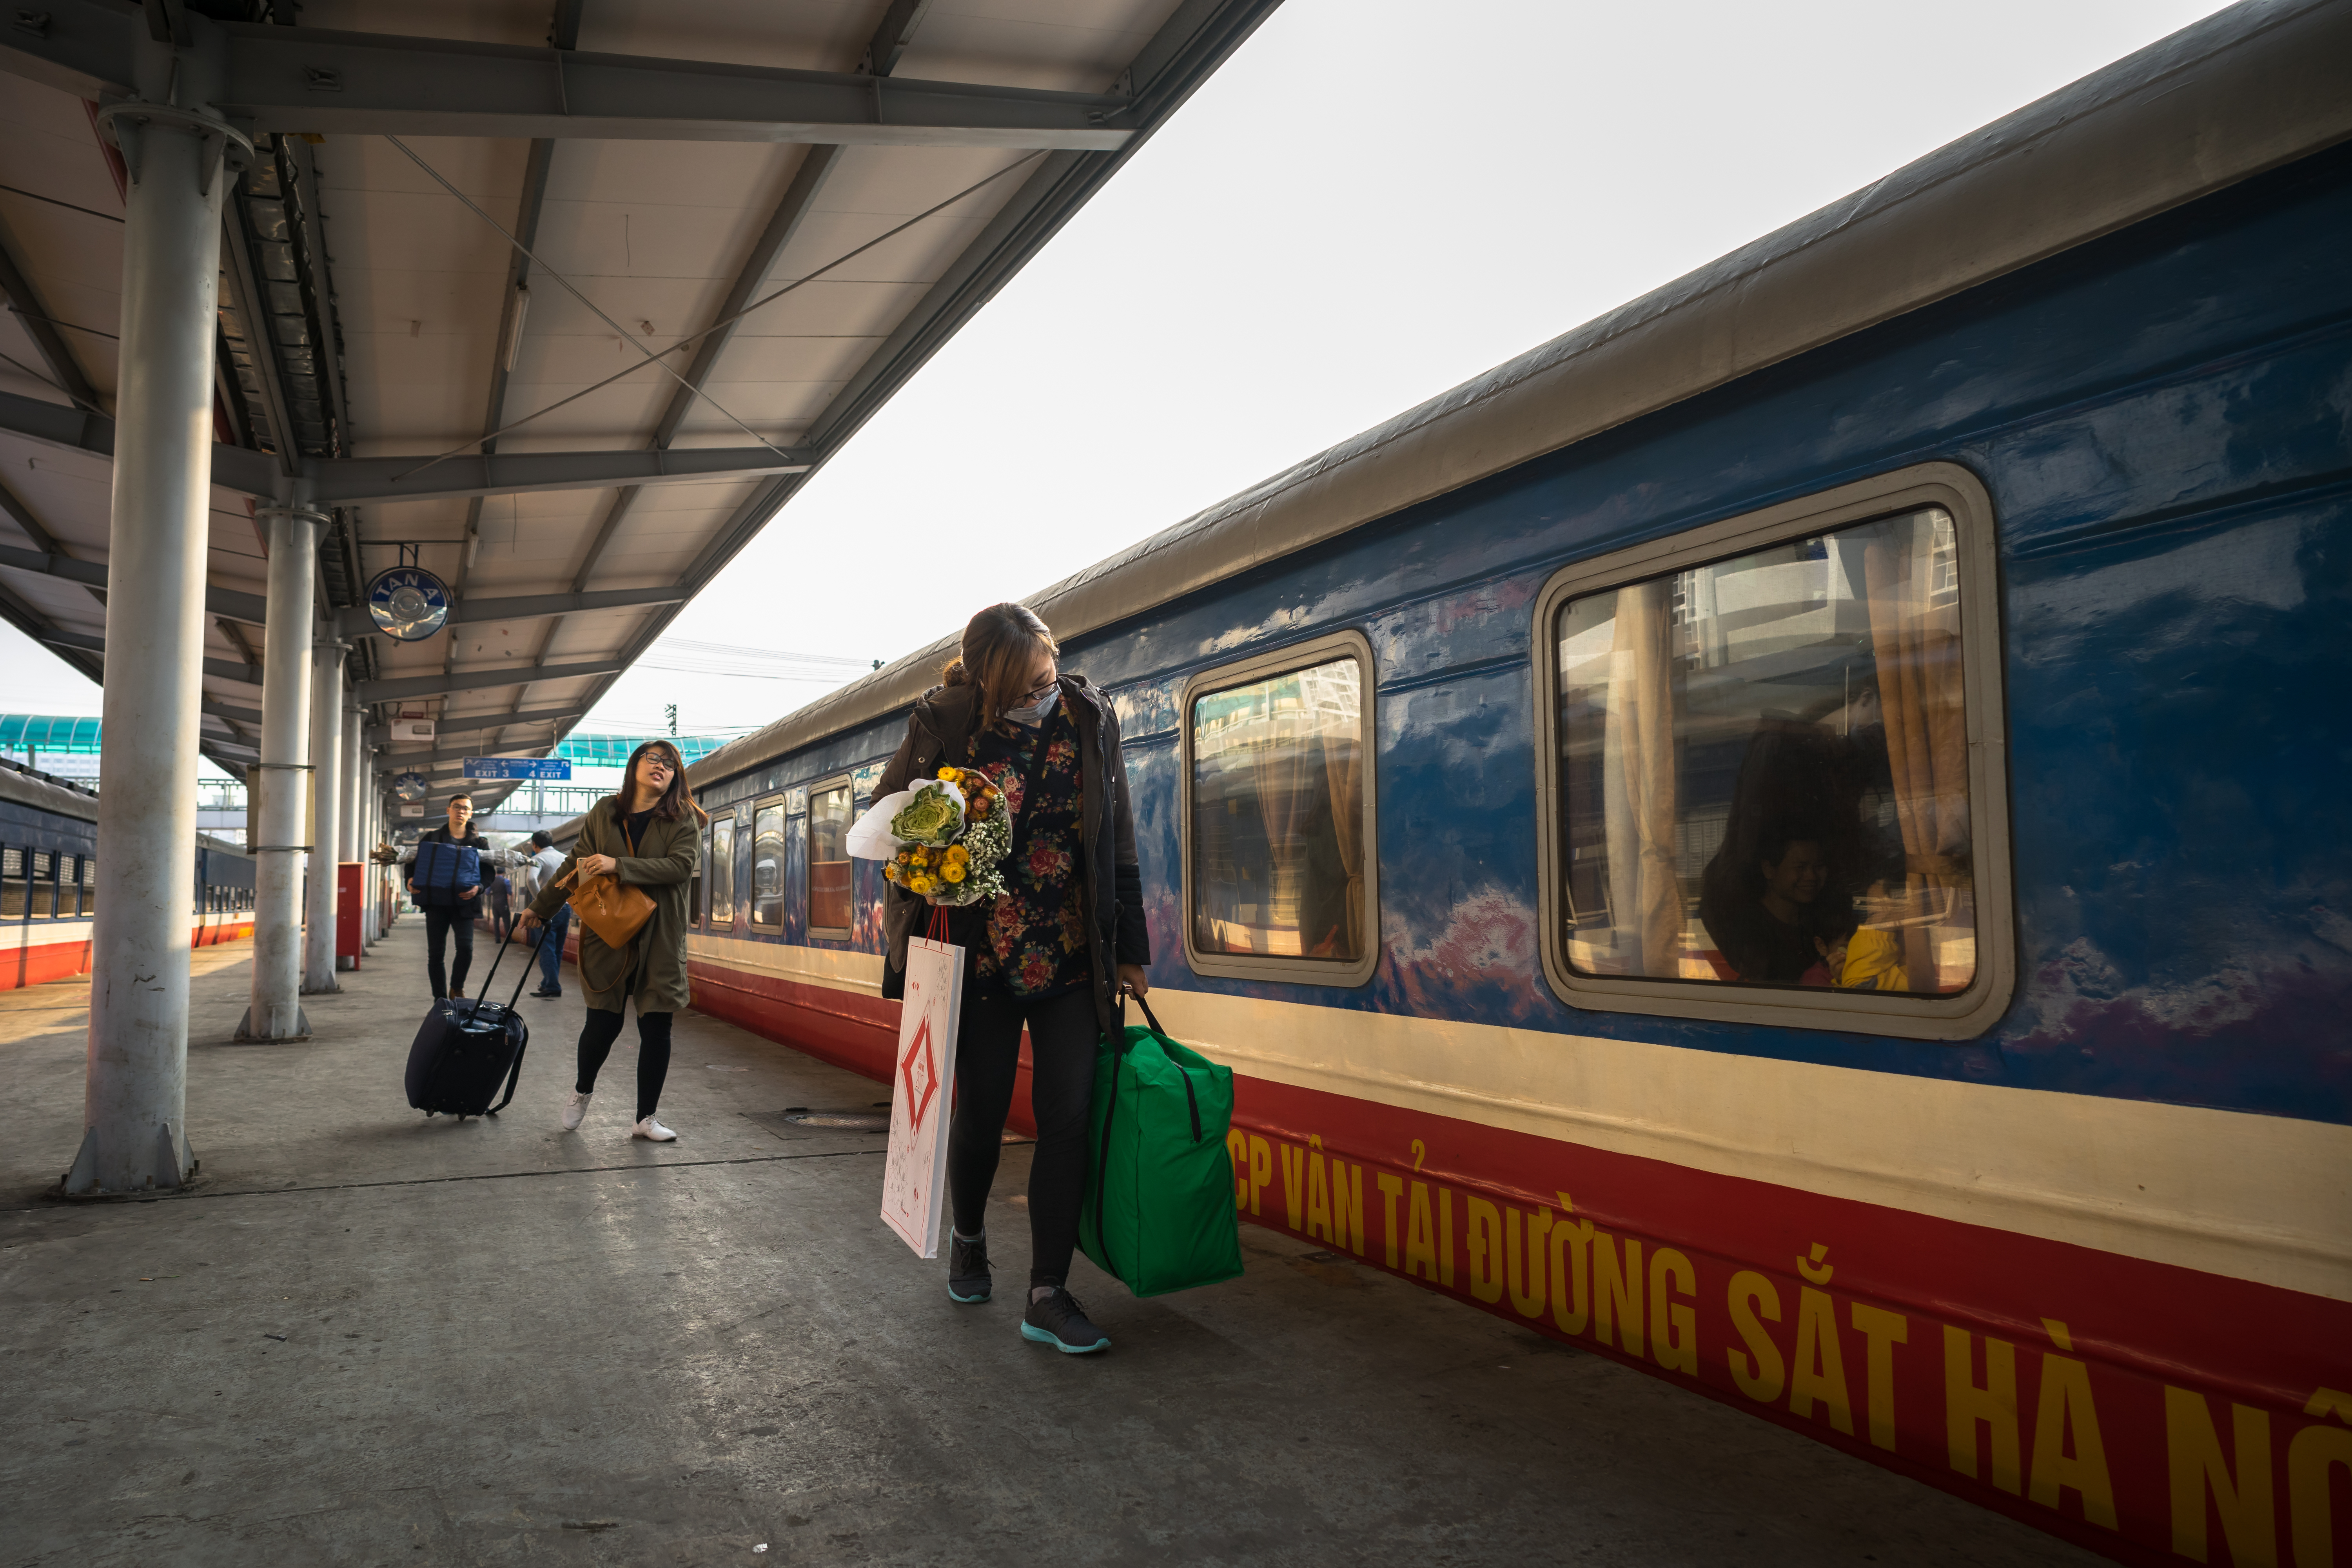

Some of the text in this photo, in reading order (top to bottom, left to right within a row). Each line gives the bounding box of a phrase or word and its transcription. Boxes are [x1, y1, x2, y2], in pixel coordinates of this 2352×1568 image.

[502, 769, 509, 777] 3
[1227, 1129, 1272, 1216] CP
[1377, 1139, 1454, 1288] TẢI
[1466, 1191, 1698, 1377] ĐƯỜNG
[1727, 1242, 1908, 1452] SẮT
[1943, 1317, 2118, 1532] HÀ
